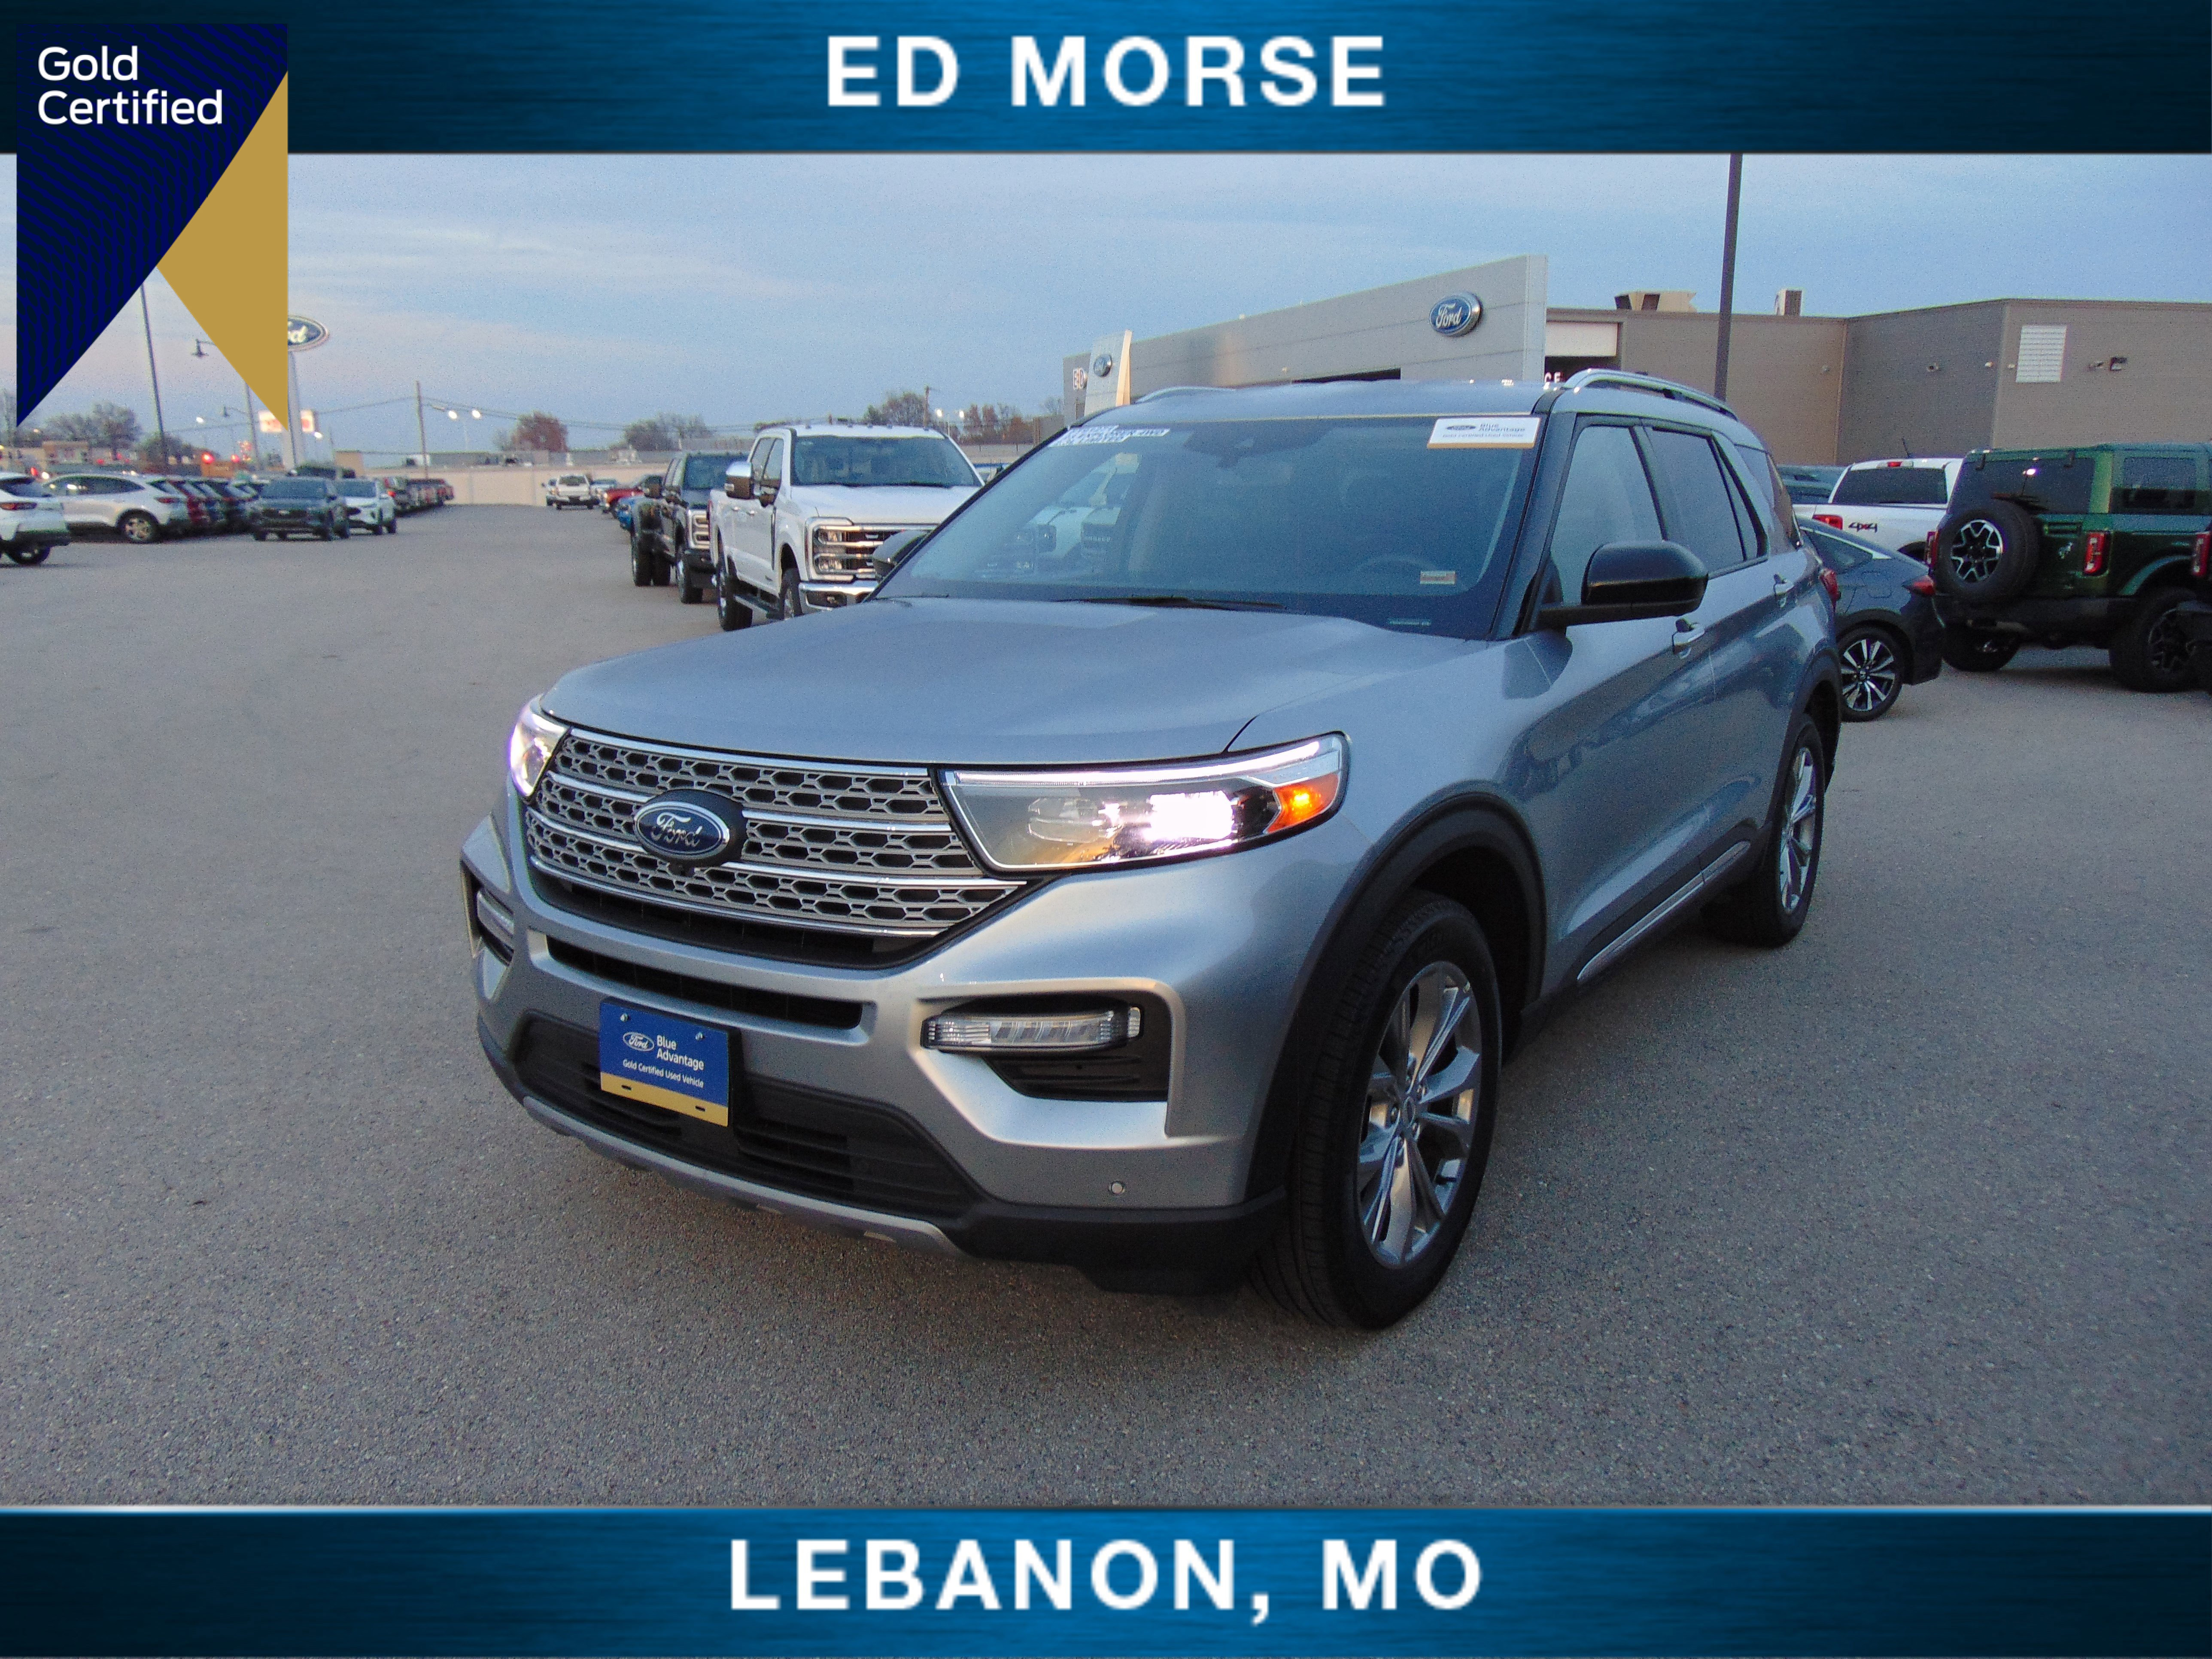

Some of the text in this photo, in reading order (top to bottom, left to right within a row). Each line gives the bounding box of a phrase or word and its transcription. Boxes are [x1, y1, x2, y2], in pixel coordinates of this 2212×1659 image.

[1436, 303, 1462, 328] Ford
[650, 811, 703, 847] Ford
[629, 1032, 648, 1050] Ford
[656, 1034, 677, 1051] Blue
[656, 1048, 705, 1071] Advantage
[623, 1059, 704, 1088] Gold Certified Used Vehicle
